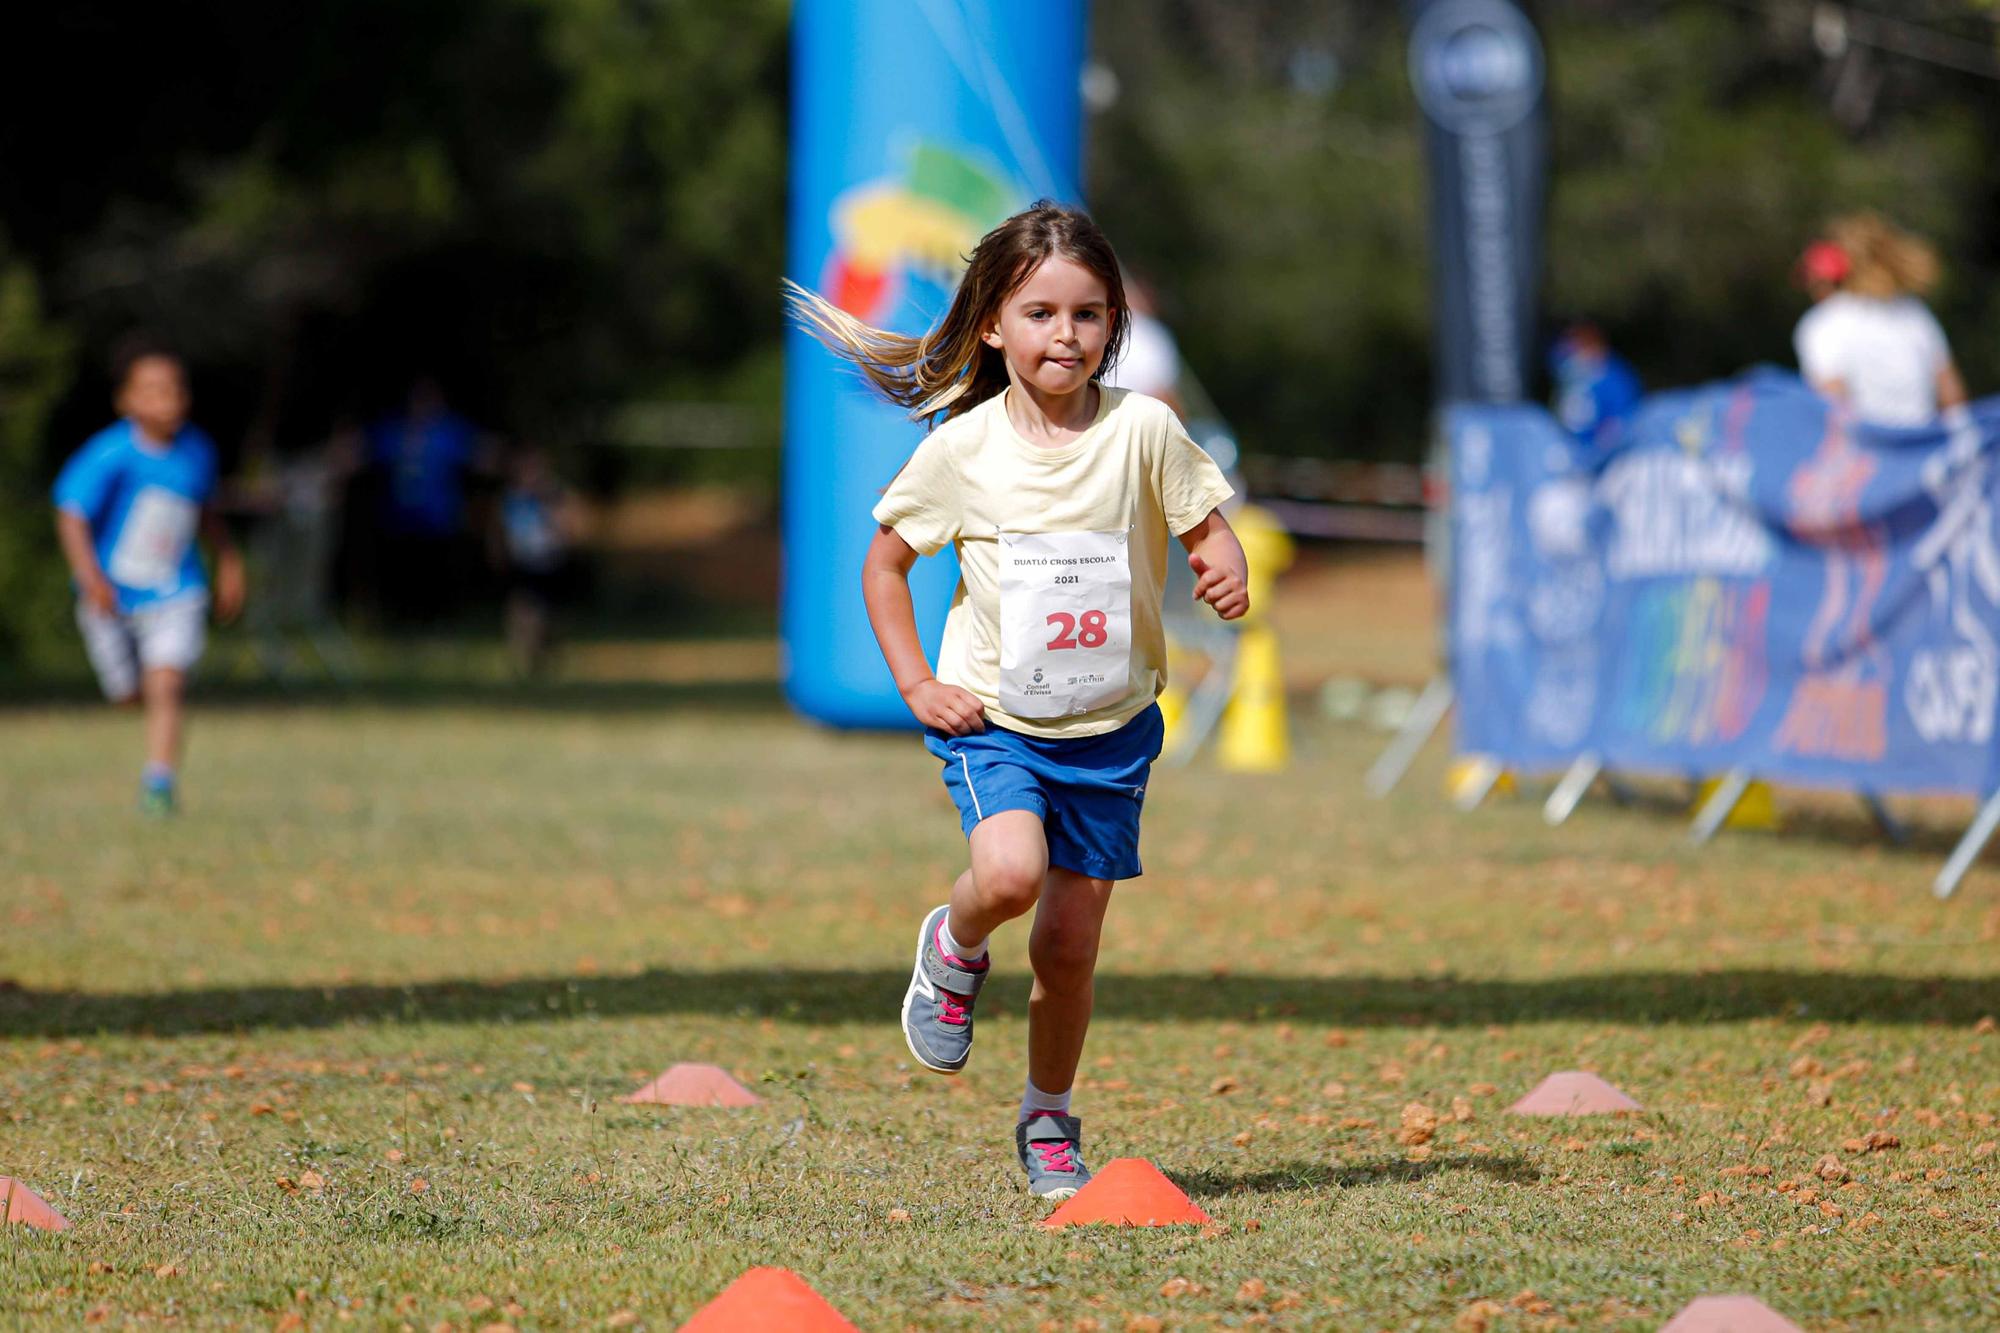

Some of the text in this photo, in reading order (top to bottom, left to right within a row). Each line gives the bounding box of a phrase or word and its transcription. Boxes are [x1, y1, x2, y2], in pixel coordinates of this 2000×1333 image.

[1013, 556, 1116, 566] DUATLÓ CROSS ESCOLAR
[1054, 575, 1079, 584] 2021
[1046, 609, 1108, 651] 28
